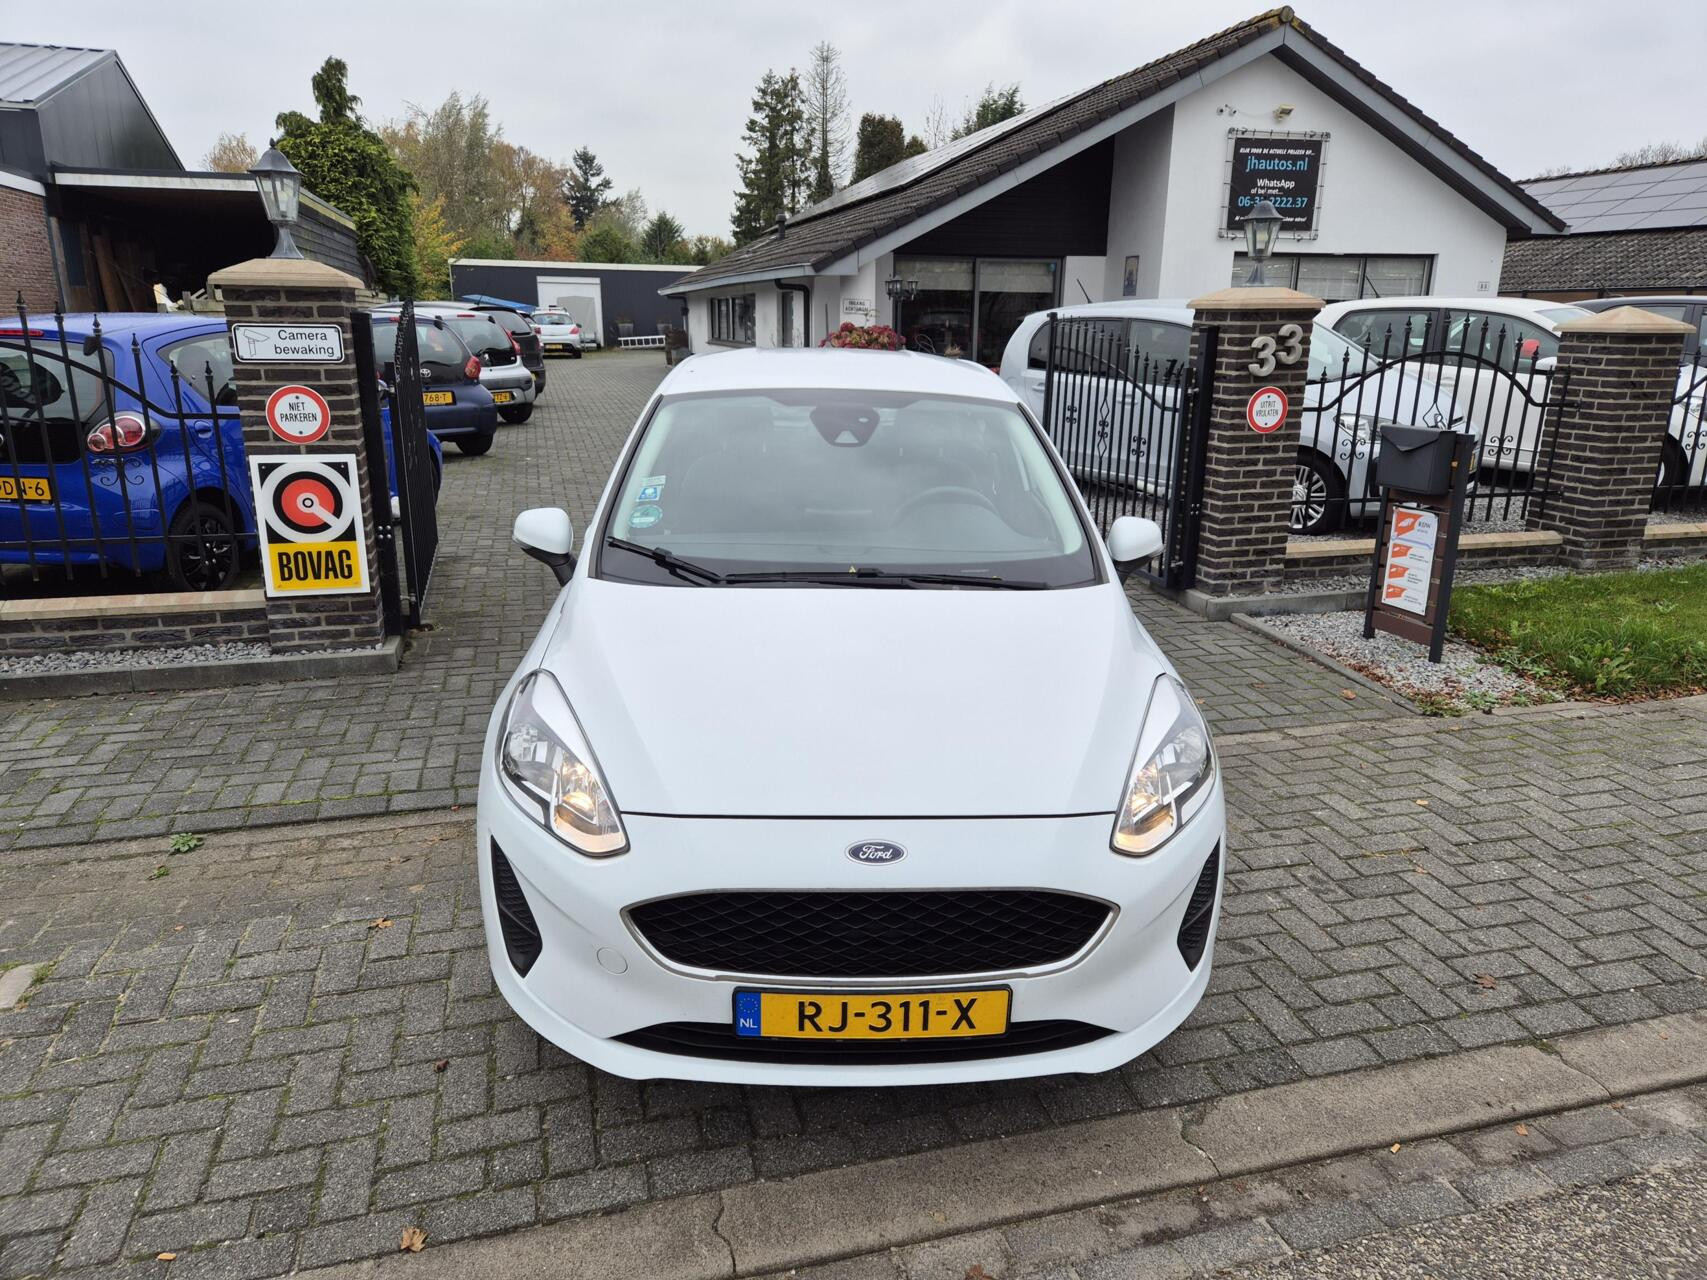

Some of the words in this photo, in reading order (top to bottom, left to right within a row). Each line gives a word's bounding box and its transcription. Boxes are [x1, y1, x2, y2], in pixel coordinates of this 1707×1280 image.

[1246, 156, 1308, 172] jhautos.nl
[1257, 179, 1295, 189] WhatsApp
[278, 330, 328, 341] Camera
[274, 344, 335, 357] bewaking
[1248, 324, 1303, 377] 33
[288, 402, 305, 411] NIET
[1260, 401, 1276, 409] UITRIT
[280, 412, 317, 422] PARKEREN
[1256, 408, 1279, 417] VRIJLATEN
[277, 549, 353, 582] BOVAG
[859, 845, 893, 859] Ford
[798, 998, 978, 1032] RJ-311-X
[739, 1018, 758, 1028] NL
